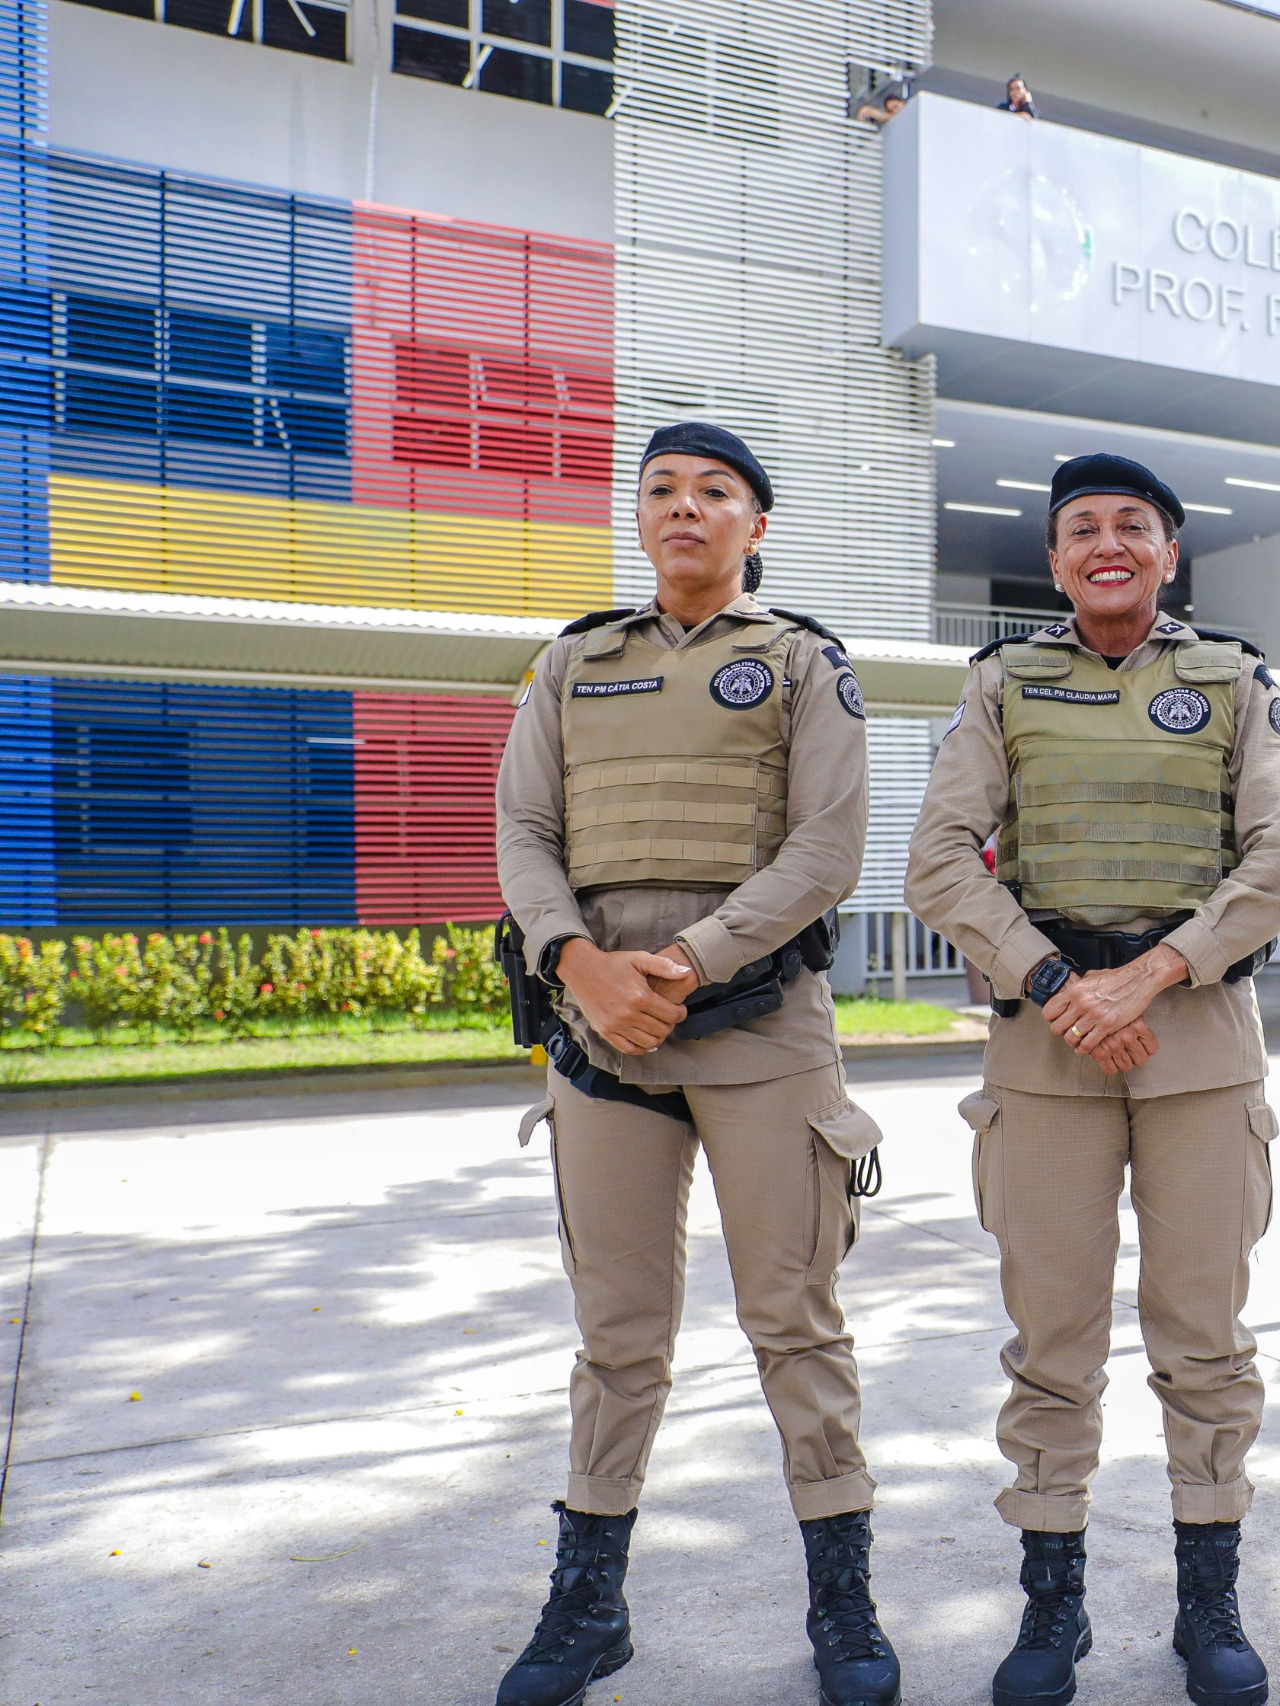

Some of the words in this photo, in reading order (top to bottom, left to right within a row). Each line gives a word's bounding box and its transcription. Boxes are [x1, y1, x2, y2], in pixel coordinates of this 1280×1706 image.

[1112, 262, 1249, 331] PROF.
[576, 685, 593, 693] TEN
[593, 685, 607, 694] PM
[607, 683, 630, 693] CÁTIA
[631, 680, 658, 690] COSTA
[1039, 687, 1053, 696] CEL
[1054, 689, 1065, 697] PM
[1097, 692, 1118, 701] MARA
